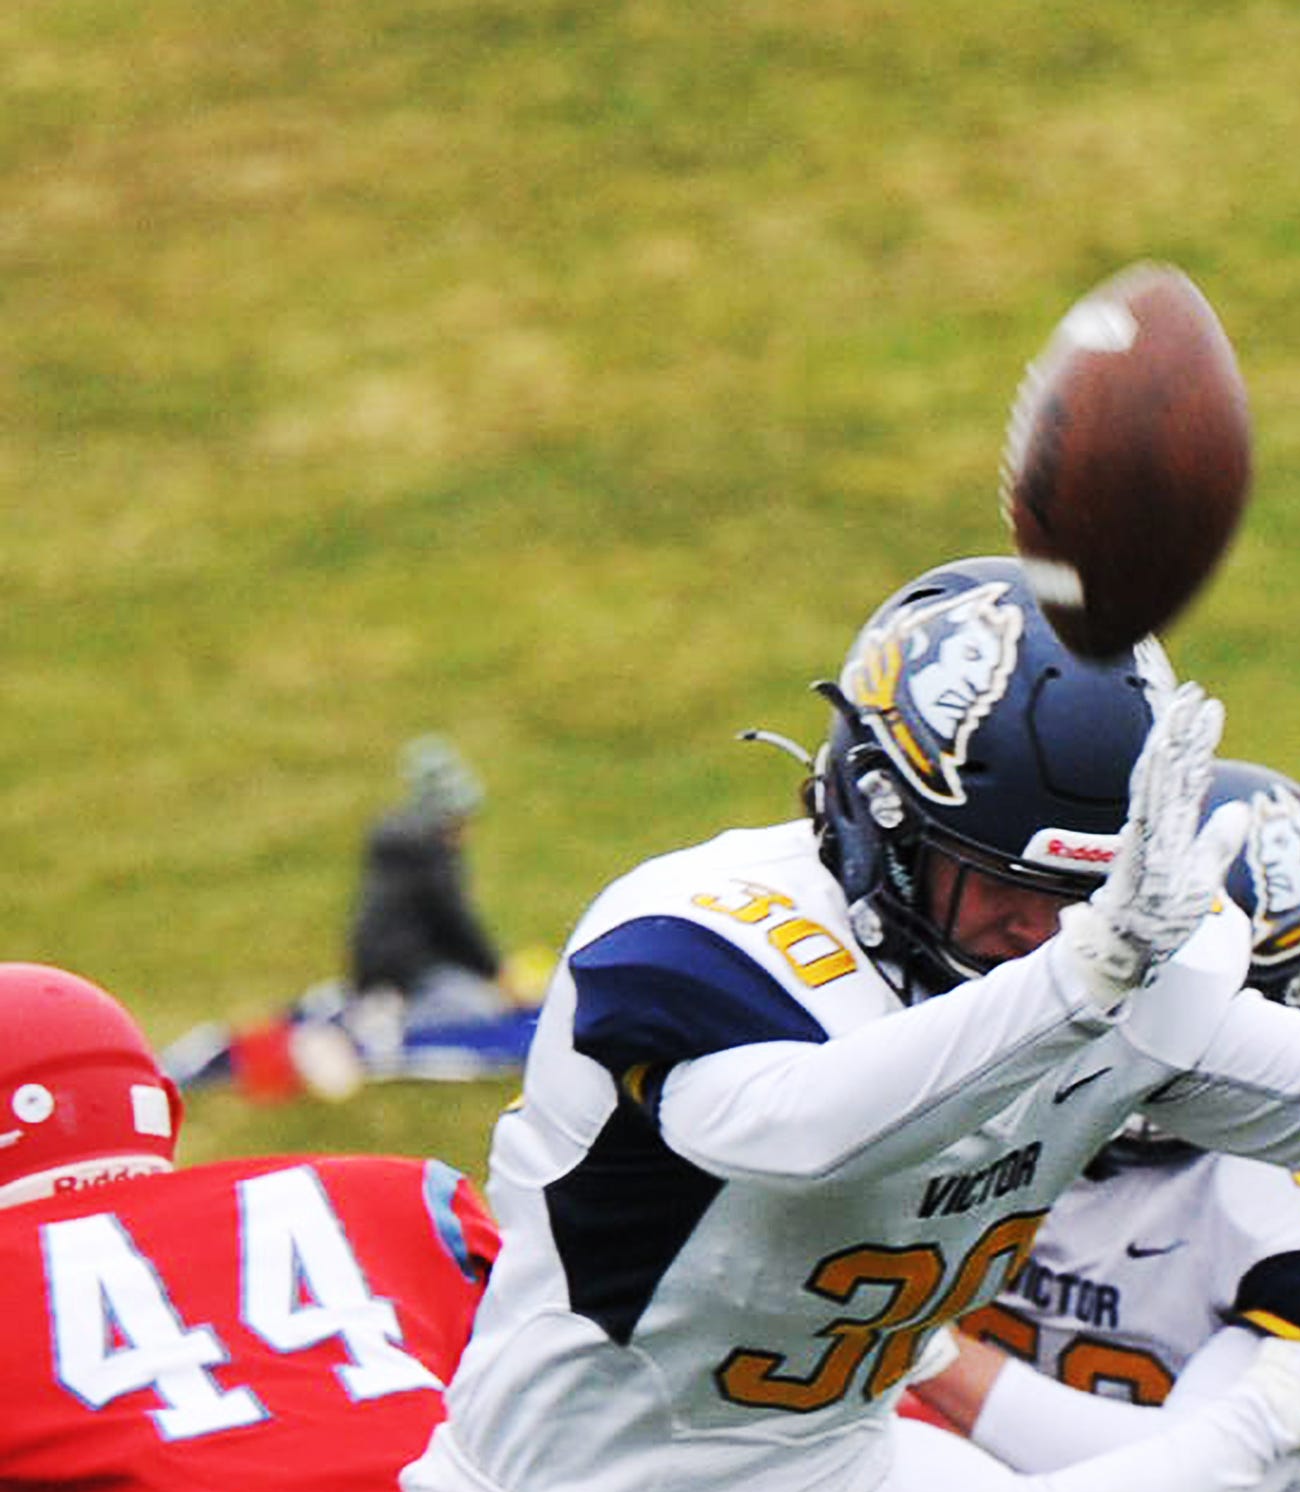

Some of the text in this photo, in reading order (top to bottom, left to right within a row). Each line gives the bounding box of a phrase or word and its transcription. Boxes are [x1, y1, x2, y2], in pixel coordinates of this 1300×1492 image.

[1047, 839, 1115, 862] Ridde
[691, 878, 858, 988] 30
[917, 1140, 1043, 1219] VICTOR
[39, 1164, 447, 1442] 44
[714, 1206, 1051, 1413] 30
[1008, 1255, 1121, 1328] ICTOR
